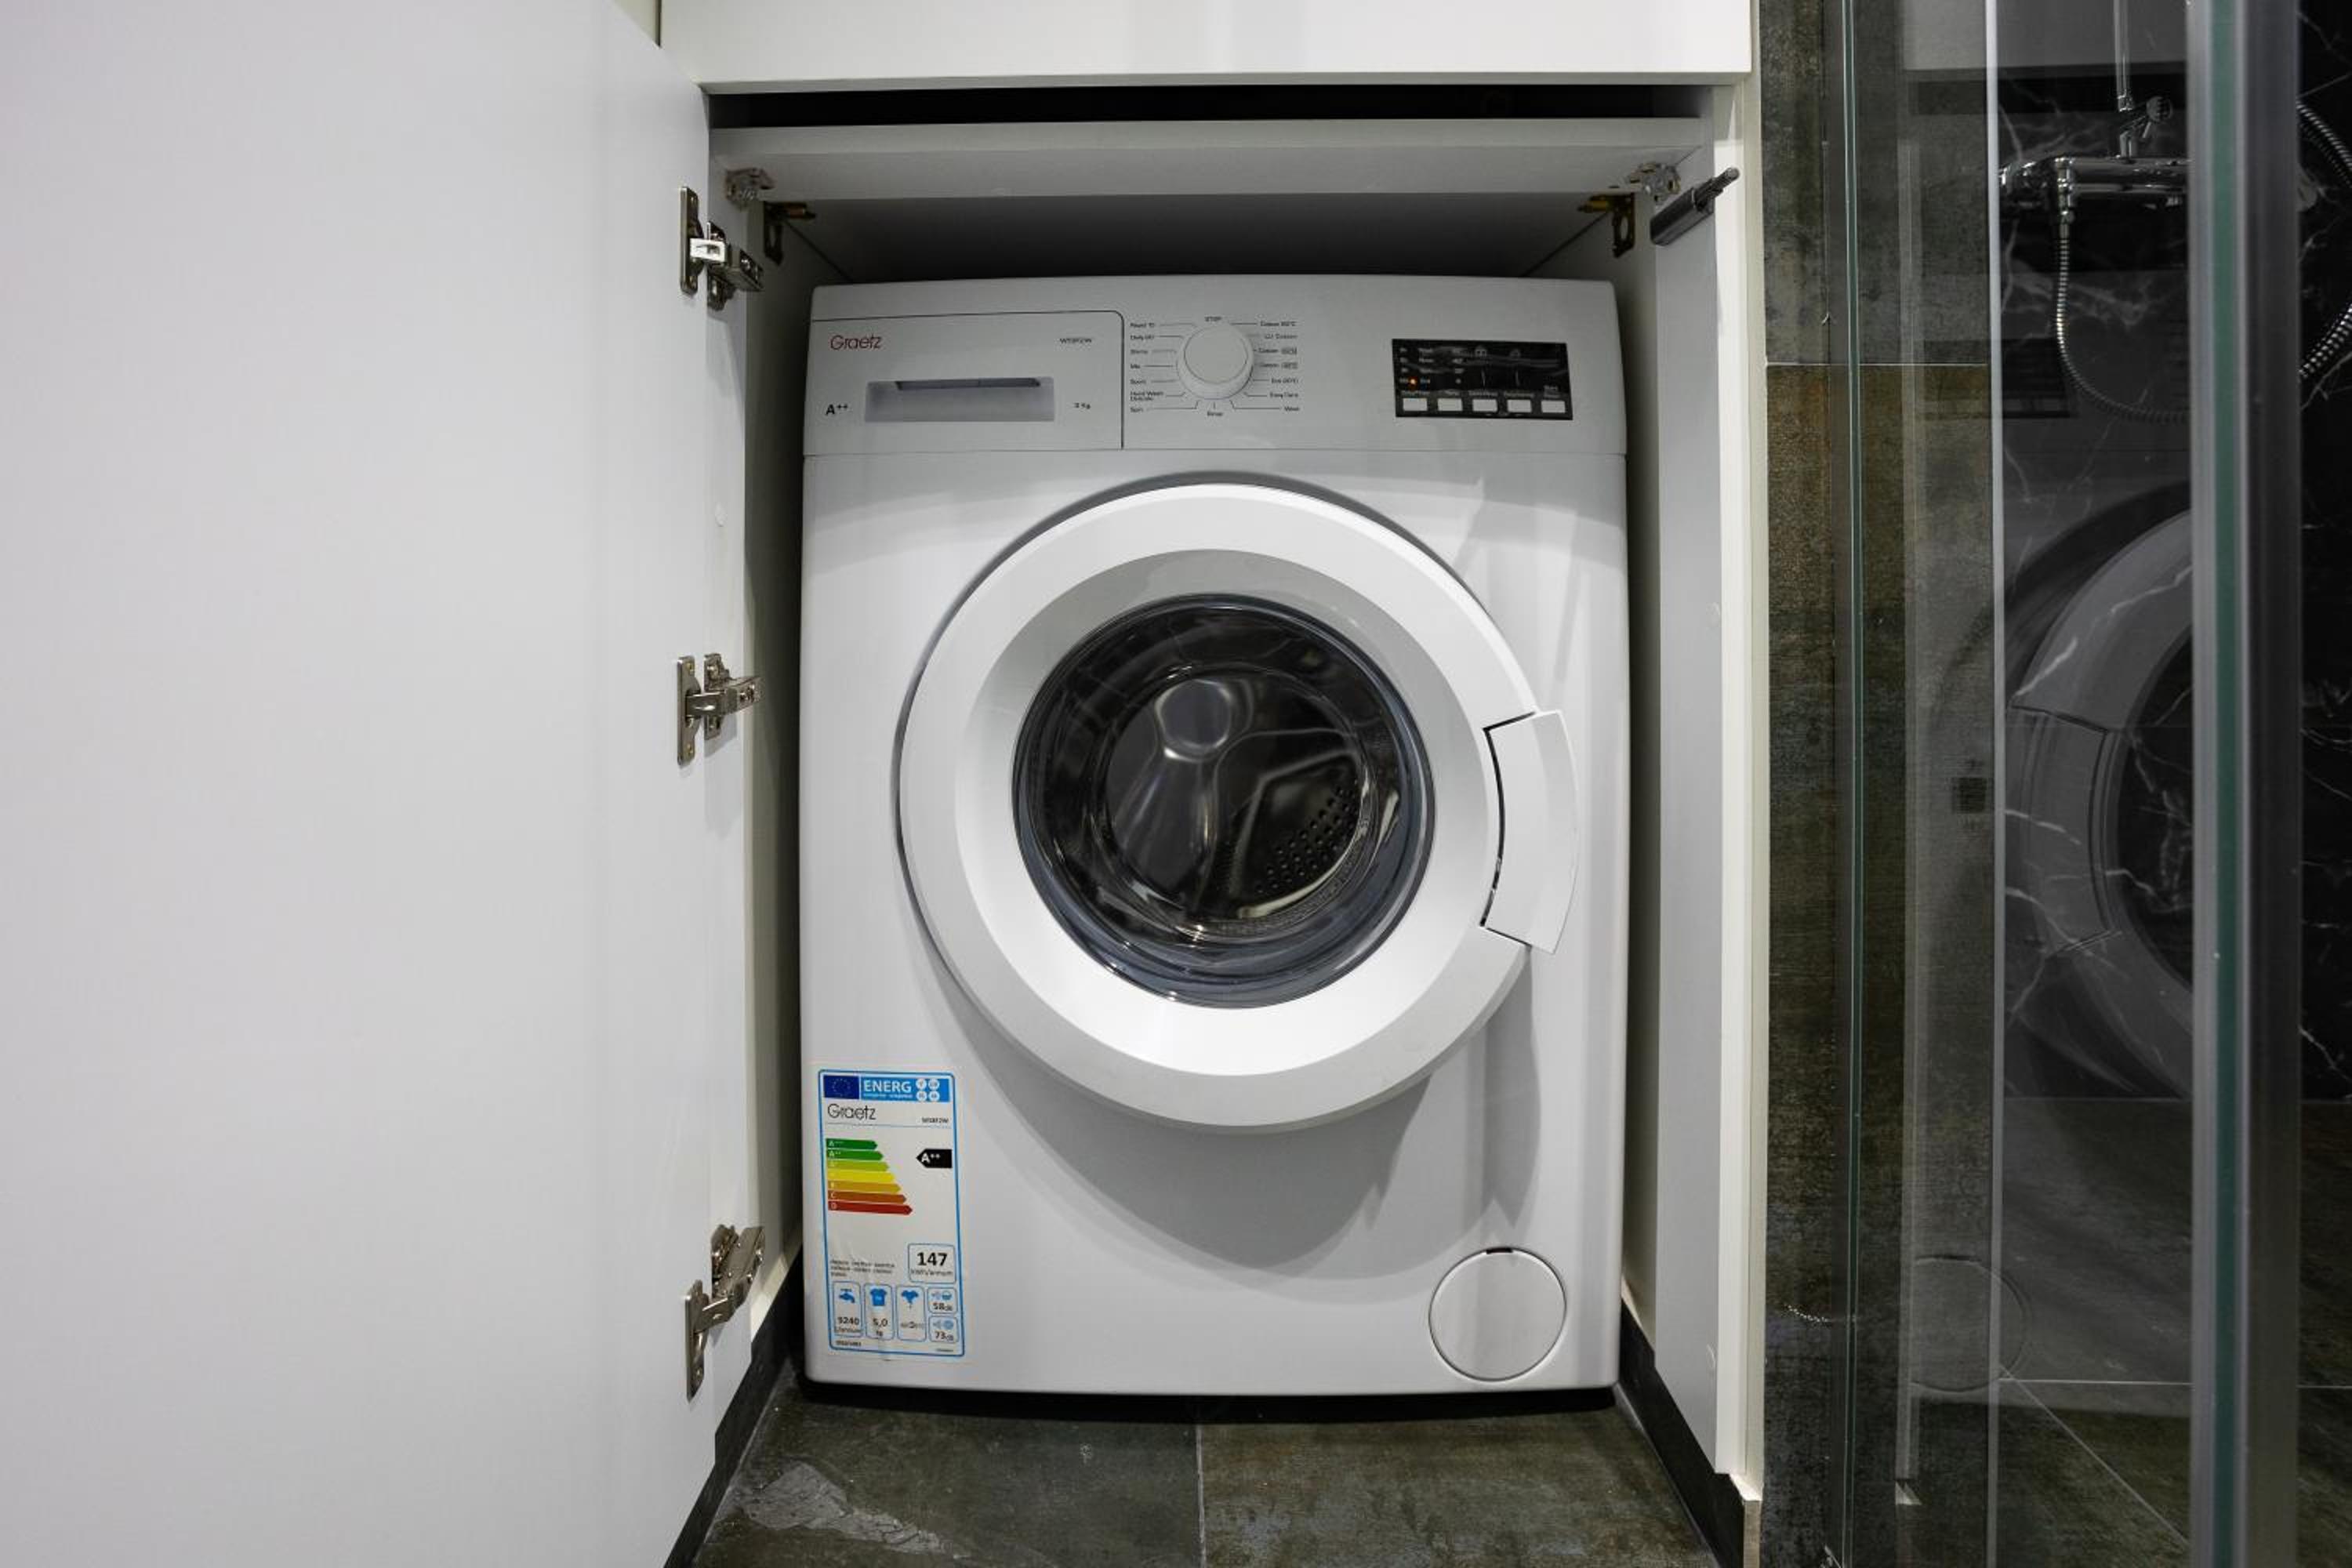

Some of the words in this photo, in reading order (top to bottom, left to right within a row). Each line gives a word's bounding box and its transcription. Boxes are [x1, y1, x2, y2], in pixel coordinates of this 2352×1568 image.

[829, 333, 883, 351] Graetz
[825, 403, 849, 416] A++
[863, 1080, 912, 1093] ENERG
[827, 1103, 877, 1120] Graetz
[920, 1152, 941, 1164] A++
[916, 1251, 949, 1267] 147
